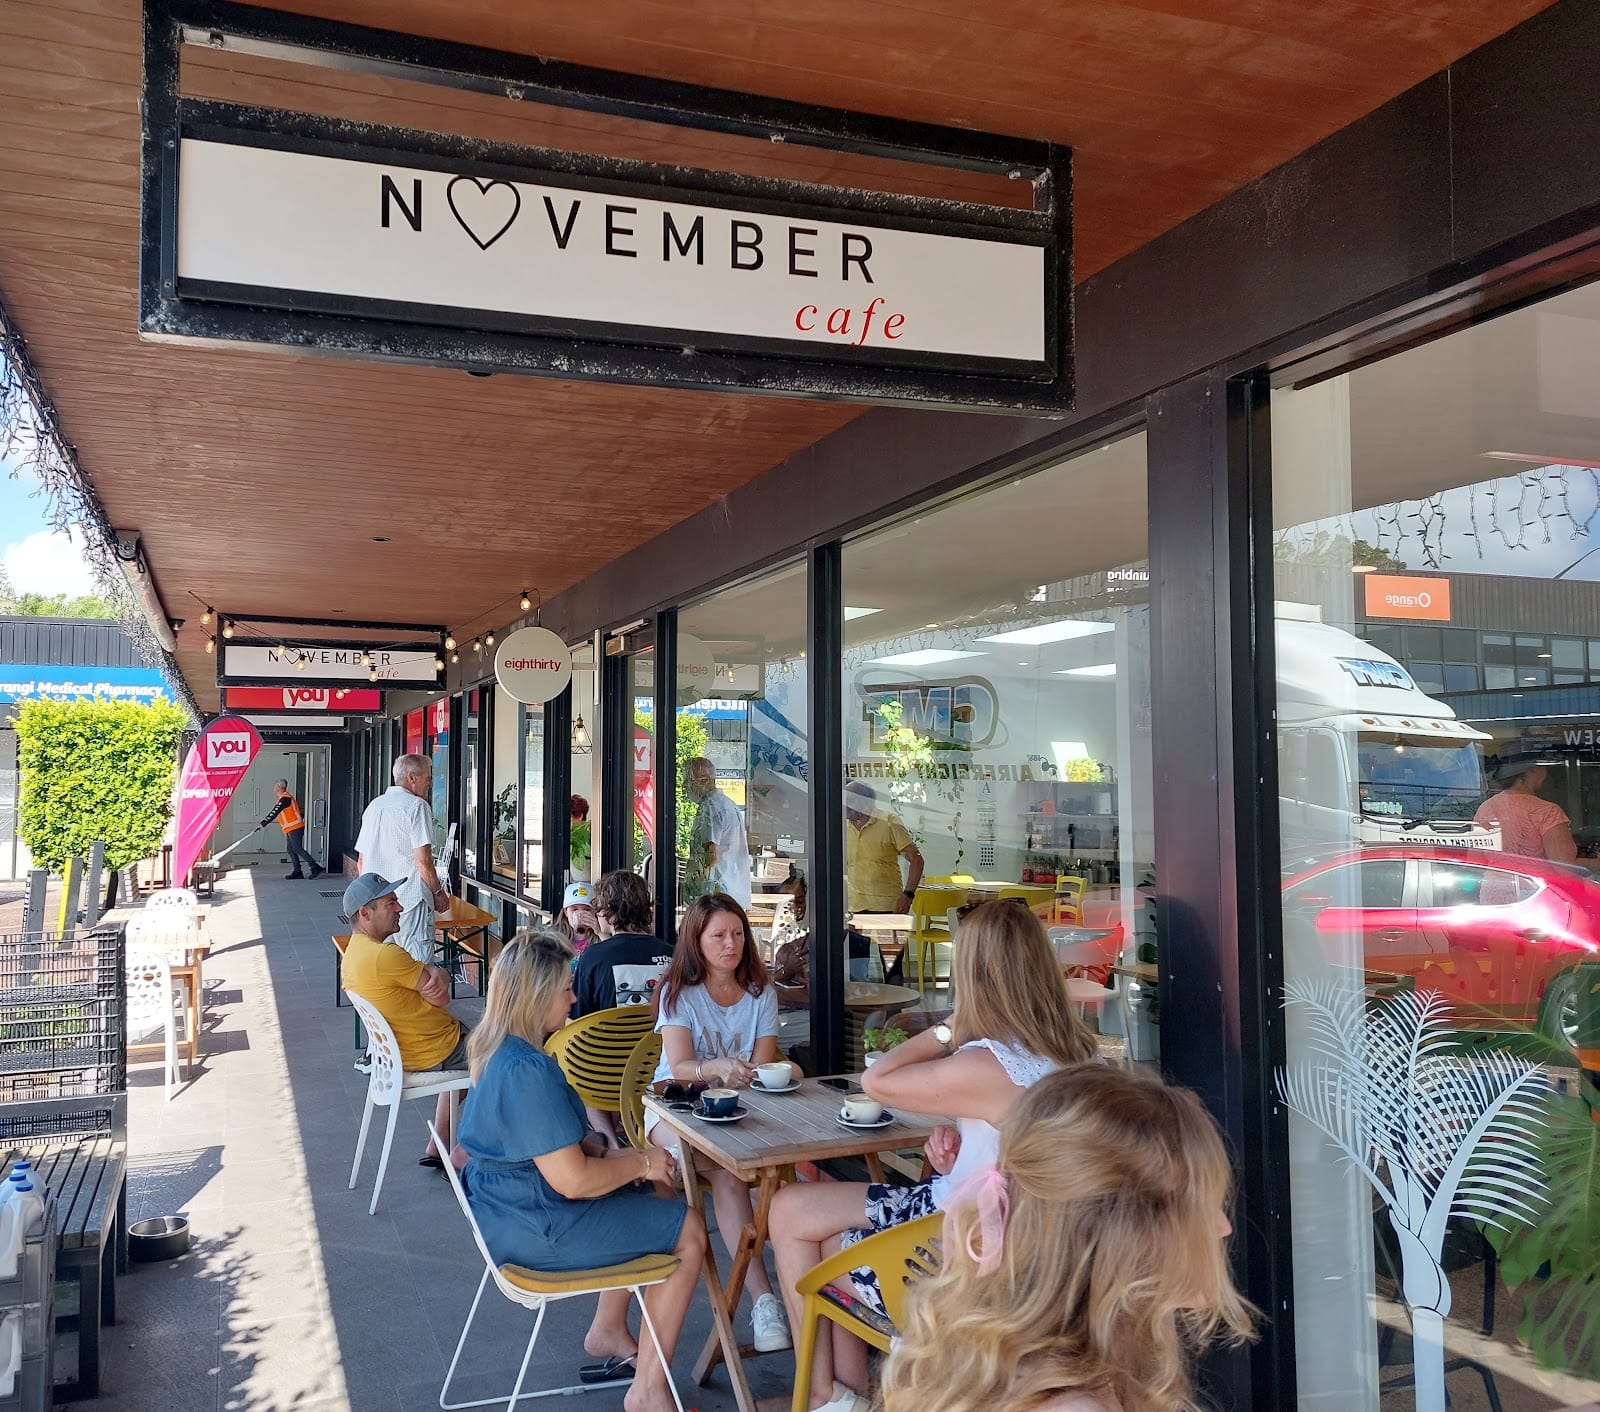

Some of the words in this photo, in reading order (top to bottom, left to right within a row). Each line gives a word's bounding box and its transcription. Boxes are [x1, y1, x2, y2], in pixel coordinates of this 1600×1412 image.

[794, 297, 906, 346] cafe
[504, 657, 562, 672] eighthirty
[374, 668, 399, 678] afe
[37, 682, 94, 695] Medical
[95, 683, 163, 697] Pharmacy
[287, 688, 325, 707] you
[212, 740, 247, 758] you
[182, 788, 209, 798] OPEN
[211, 787, 233, 798] NOW
